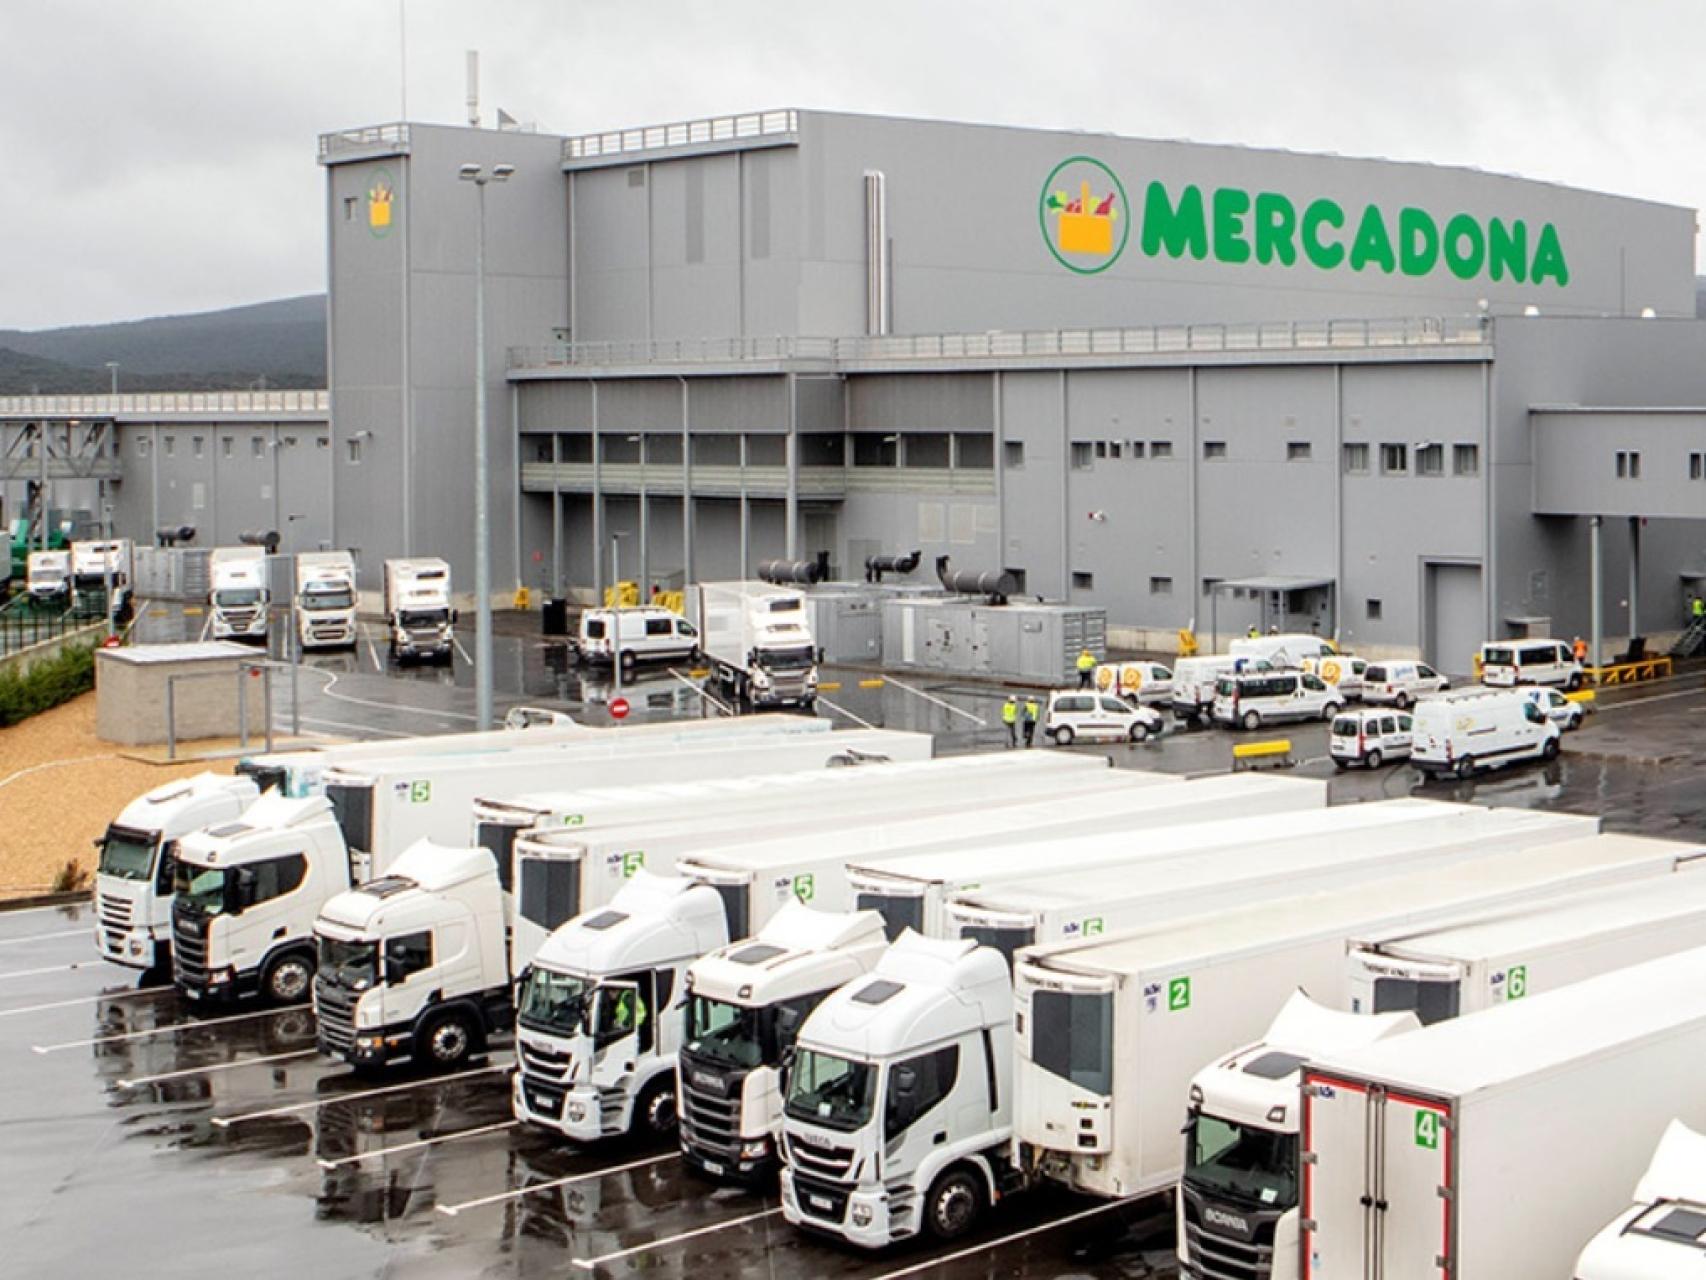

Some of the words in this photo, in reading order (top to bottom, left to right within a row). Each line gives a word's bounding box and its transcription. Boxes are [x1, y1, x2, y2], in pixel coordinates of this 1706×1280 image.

[1142, 181, 1569, 287] MERCADONA
[414, 780, 428, 801] 5
[796, 874, 812, 899] 5
[1171, 981, 1187, 1007] 2
[1510, 967, 1525, 997] 6
[1417, 1112, 1435, 1147] 4
